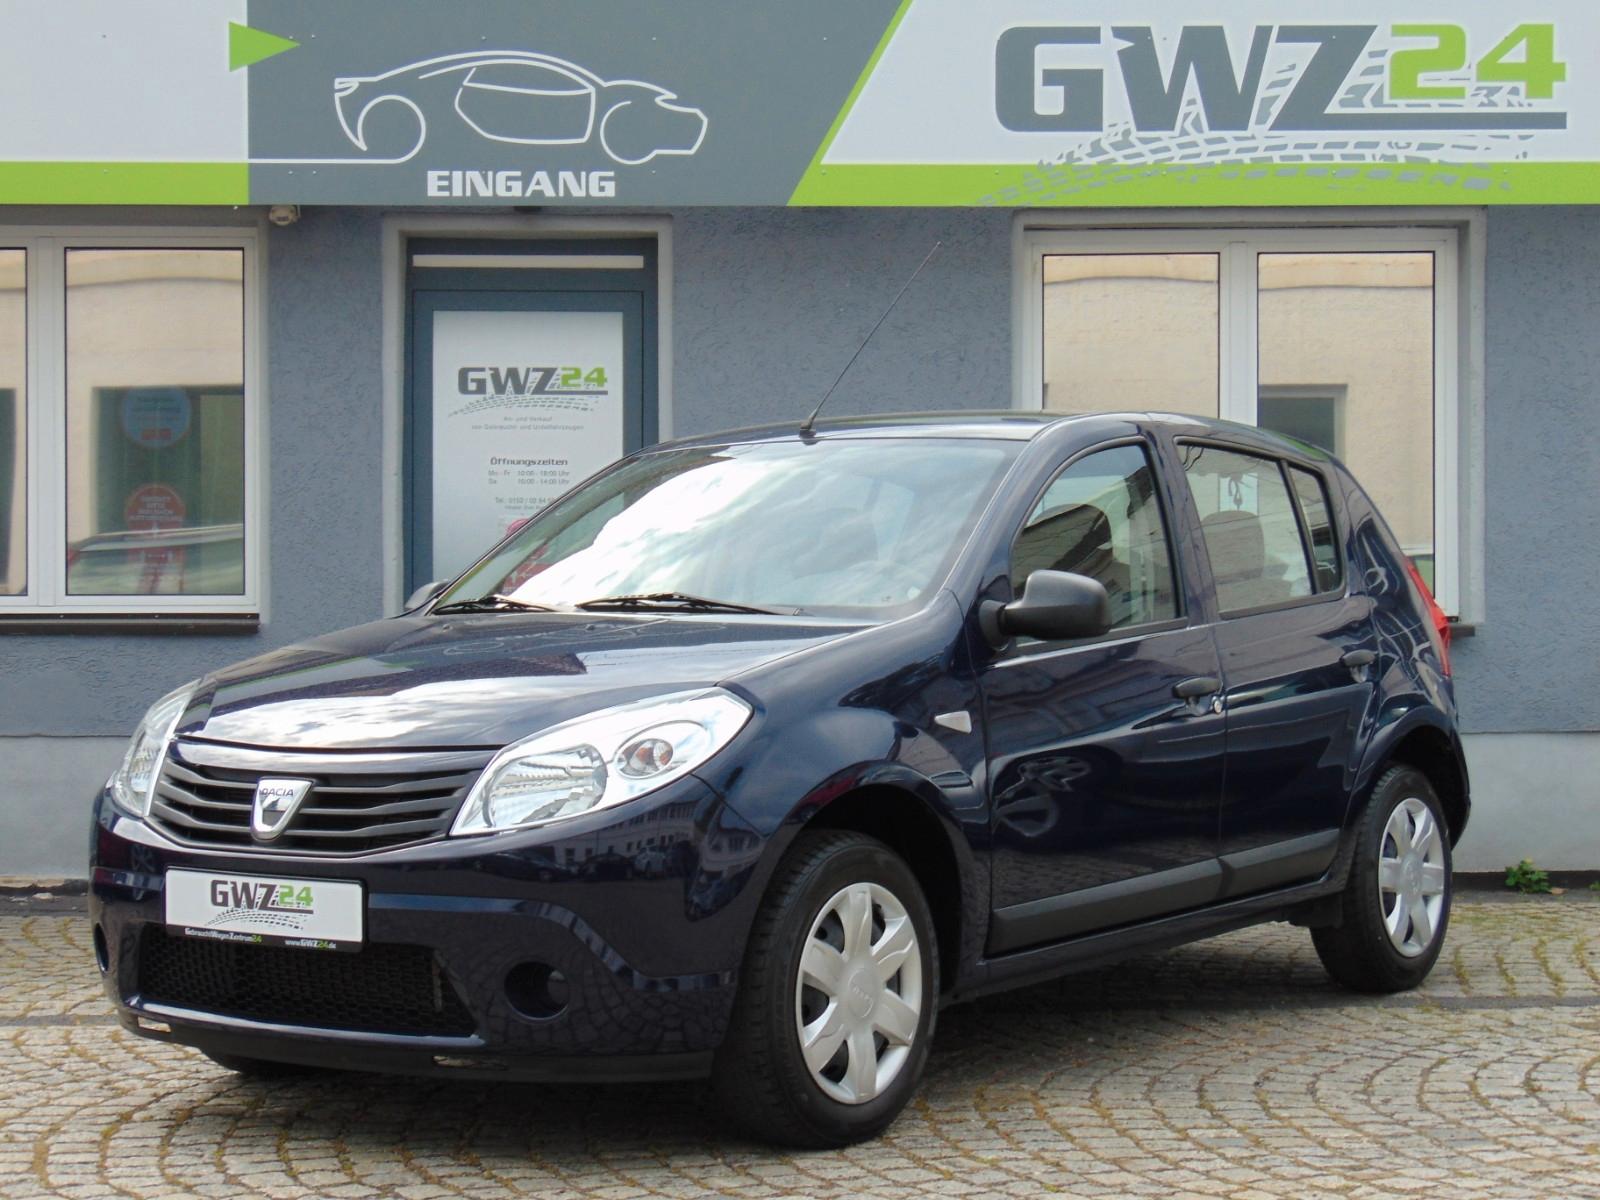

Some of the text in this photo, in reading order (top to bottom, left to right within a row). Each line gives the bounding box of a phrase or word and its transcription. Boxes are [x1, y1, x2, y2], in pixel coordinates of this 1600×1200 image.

[995, 23, 1567, 133] GWZ24
[427, 170, 616, 197] EINGANG
[458, 366, 609, 396] GWZ24
[489, 456, 568, 467] Öffnungszeiten
[260, 787, 294, 797] DACIA
[210, 879, 314, 915] GWZ24
